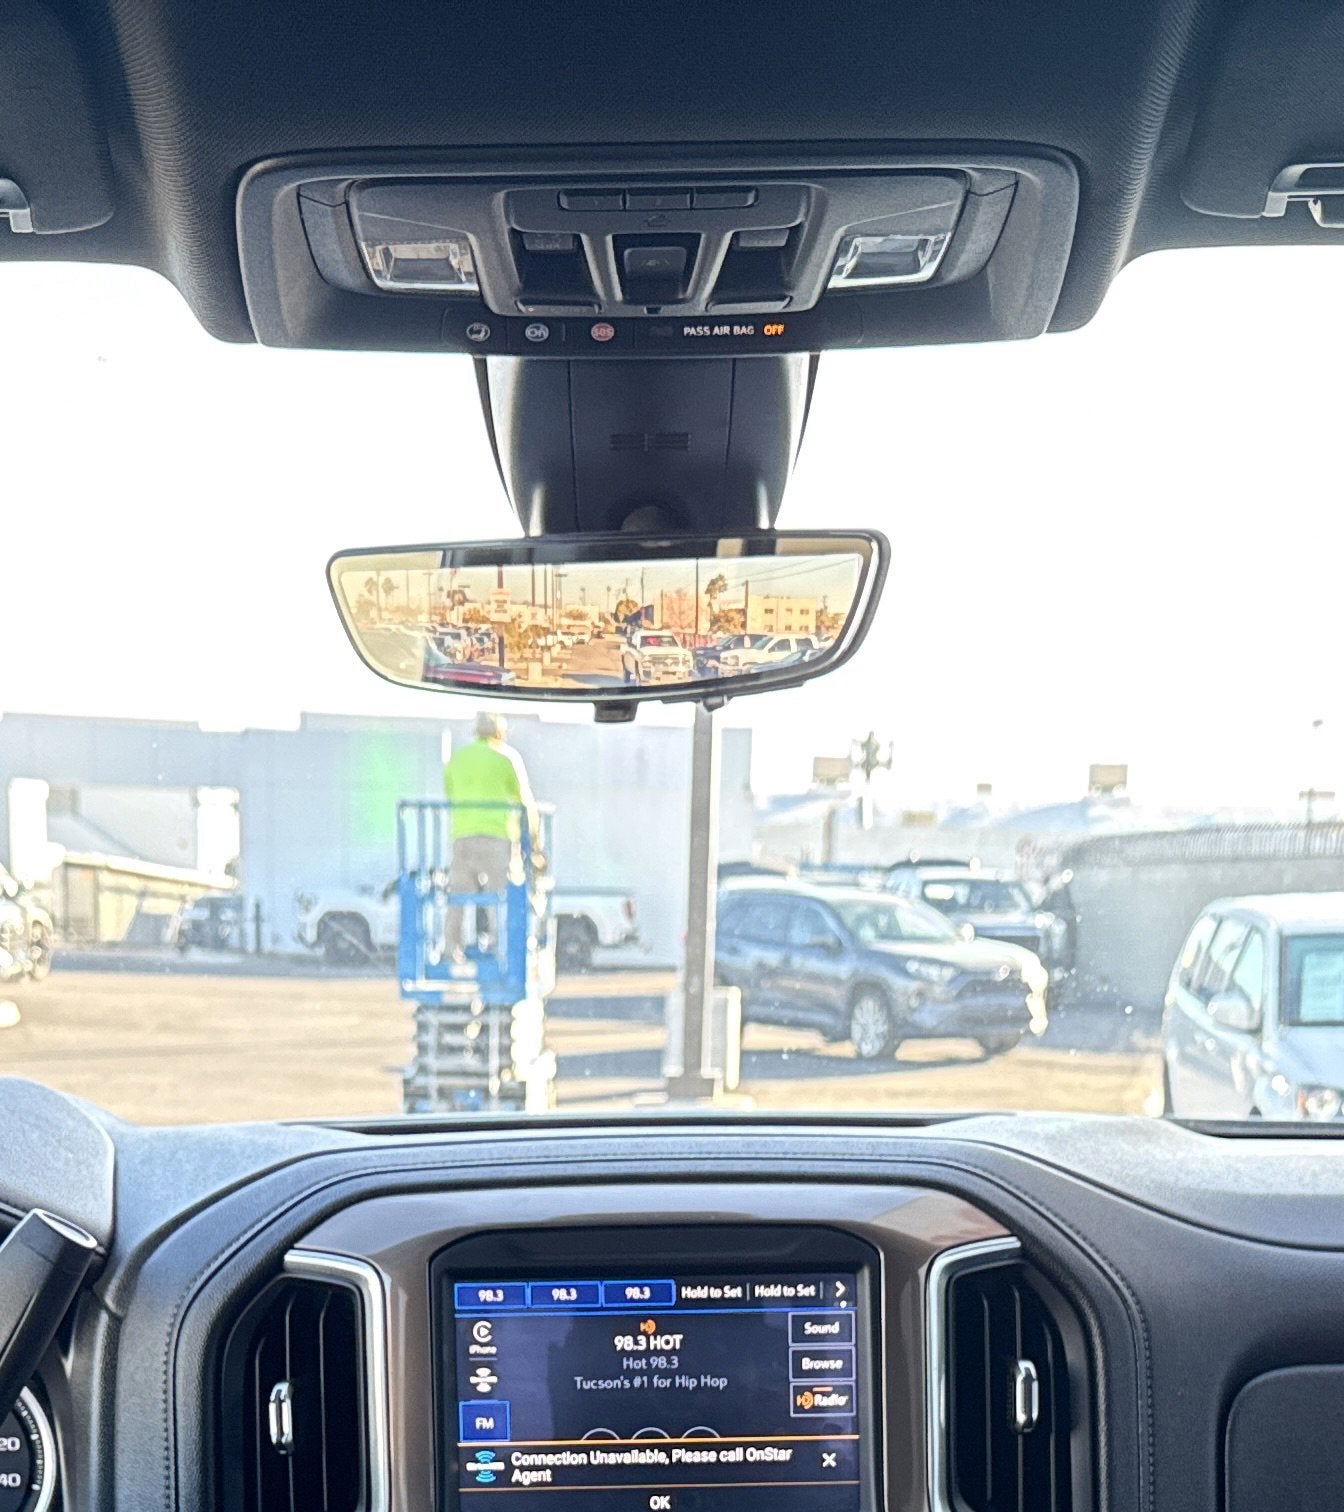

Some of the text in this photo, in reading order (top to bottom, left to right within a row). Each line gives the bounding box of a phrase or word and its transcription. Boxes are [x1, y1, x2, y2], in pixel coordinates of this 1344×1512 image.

[683, 324, 785, 336] PASS AIR BAG OFF
[478, 1289, 504, 1302] 98.3
[551, 1288, 577, 1302] 98.3
[625, 1286, 651, 1300] 98.3
[681, 1285, 743, 1299] Hold to Set
[754, 1283, 816, 1297] Hold to Set
[804, 1321, 840, 1335] Sound
[613, 1334, 683, 1352] 98.3 HOT
[622, 1356, 679, 1370] Hot 98.3
[801, 1357, 844, 1371] Browse
[574, 1375, 728, 1392] Tucson's #1 for Hip Hop
[475, 1418, 494, 1430] FM
[510, 1451, 587, 1467] Connection
[589, 1449, 669, 1467] Unavailable,
[672, 1448, 716, 1464] Please
[719, 1447, 743, 1463] call
[746, 1446, 792, 1462] OnStar
[510, 1468, 552, 1485] Agent
[649, 1496, 670, 1511] OK
